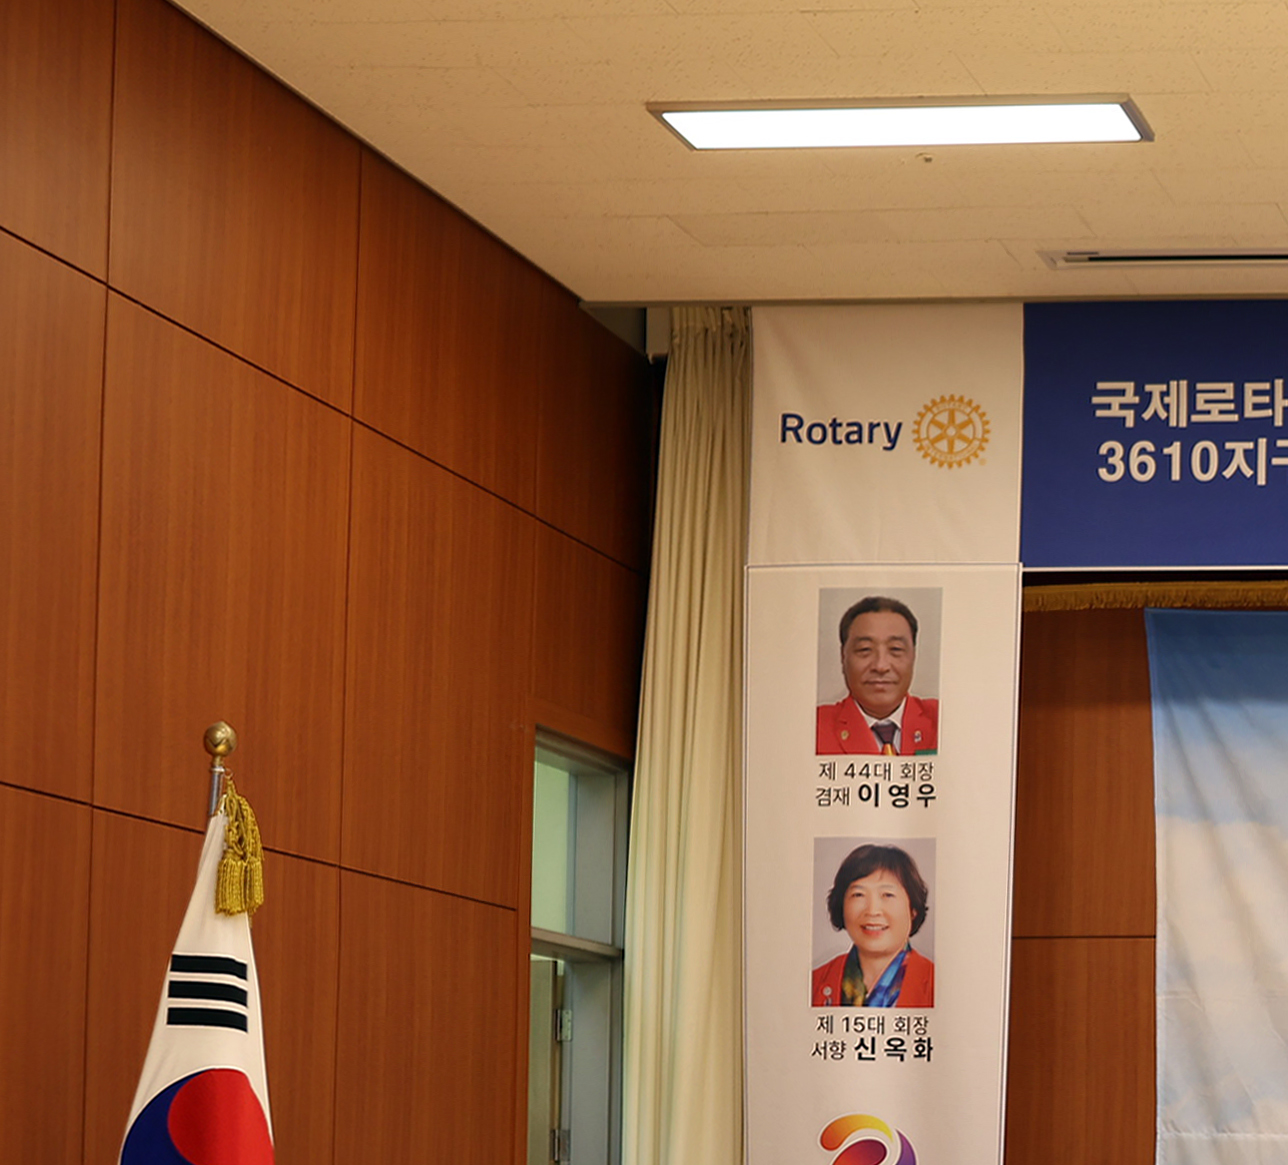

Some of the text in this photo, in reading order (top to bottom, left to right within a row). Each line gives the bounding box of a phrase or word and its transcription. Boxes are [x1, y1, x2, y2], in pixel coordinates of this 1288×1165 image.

[780, 413, 903, 450] Rotary
[819, 761, 934, 781] 제 44대 회장
[816, 1016, 929, 1035] 제 15대 회장
[811, 1041, 846, 1060] 서향
